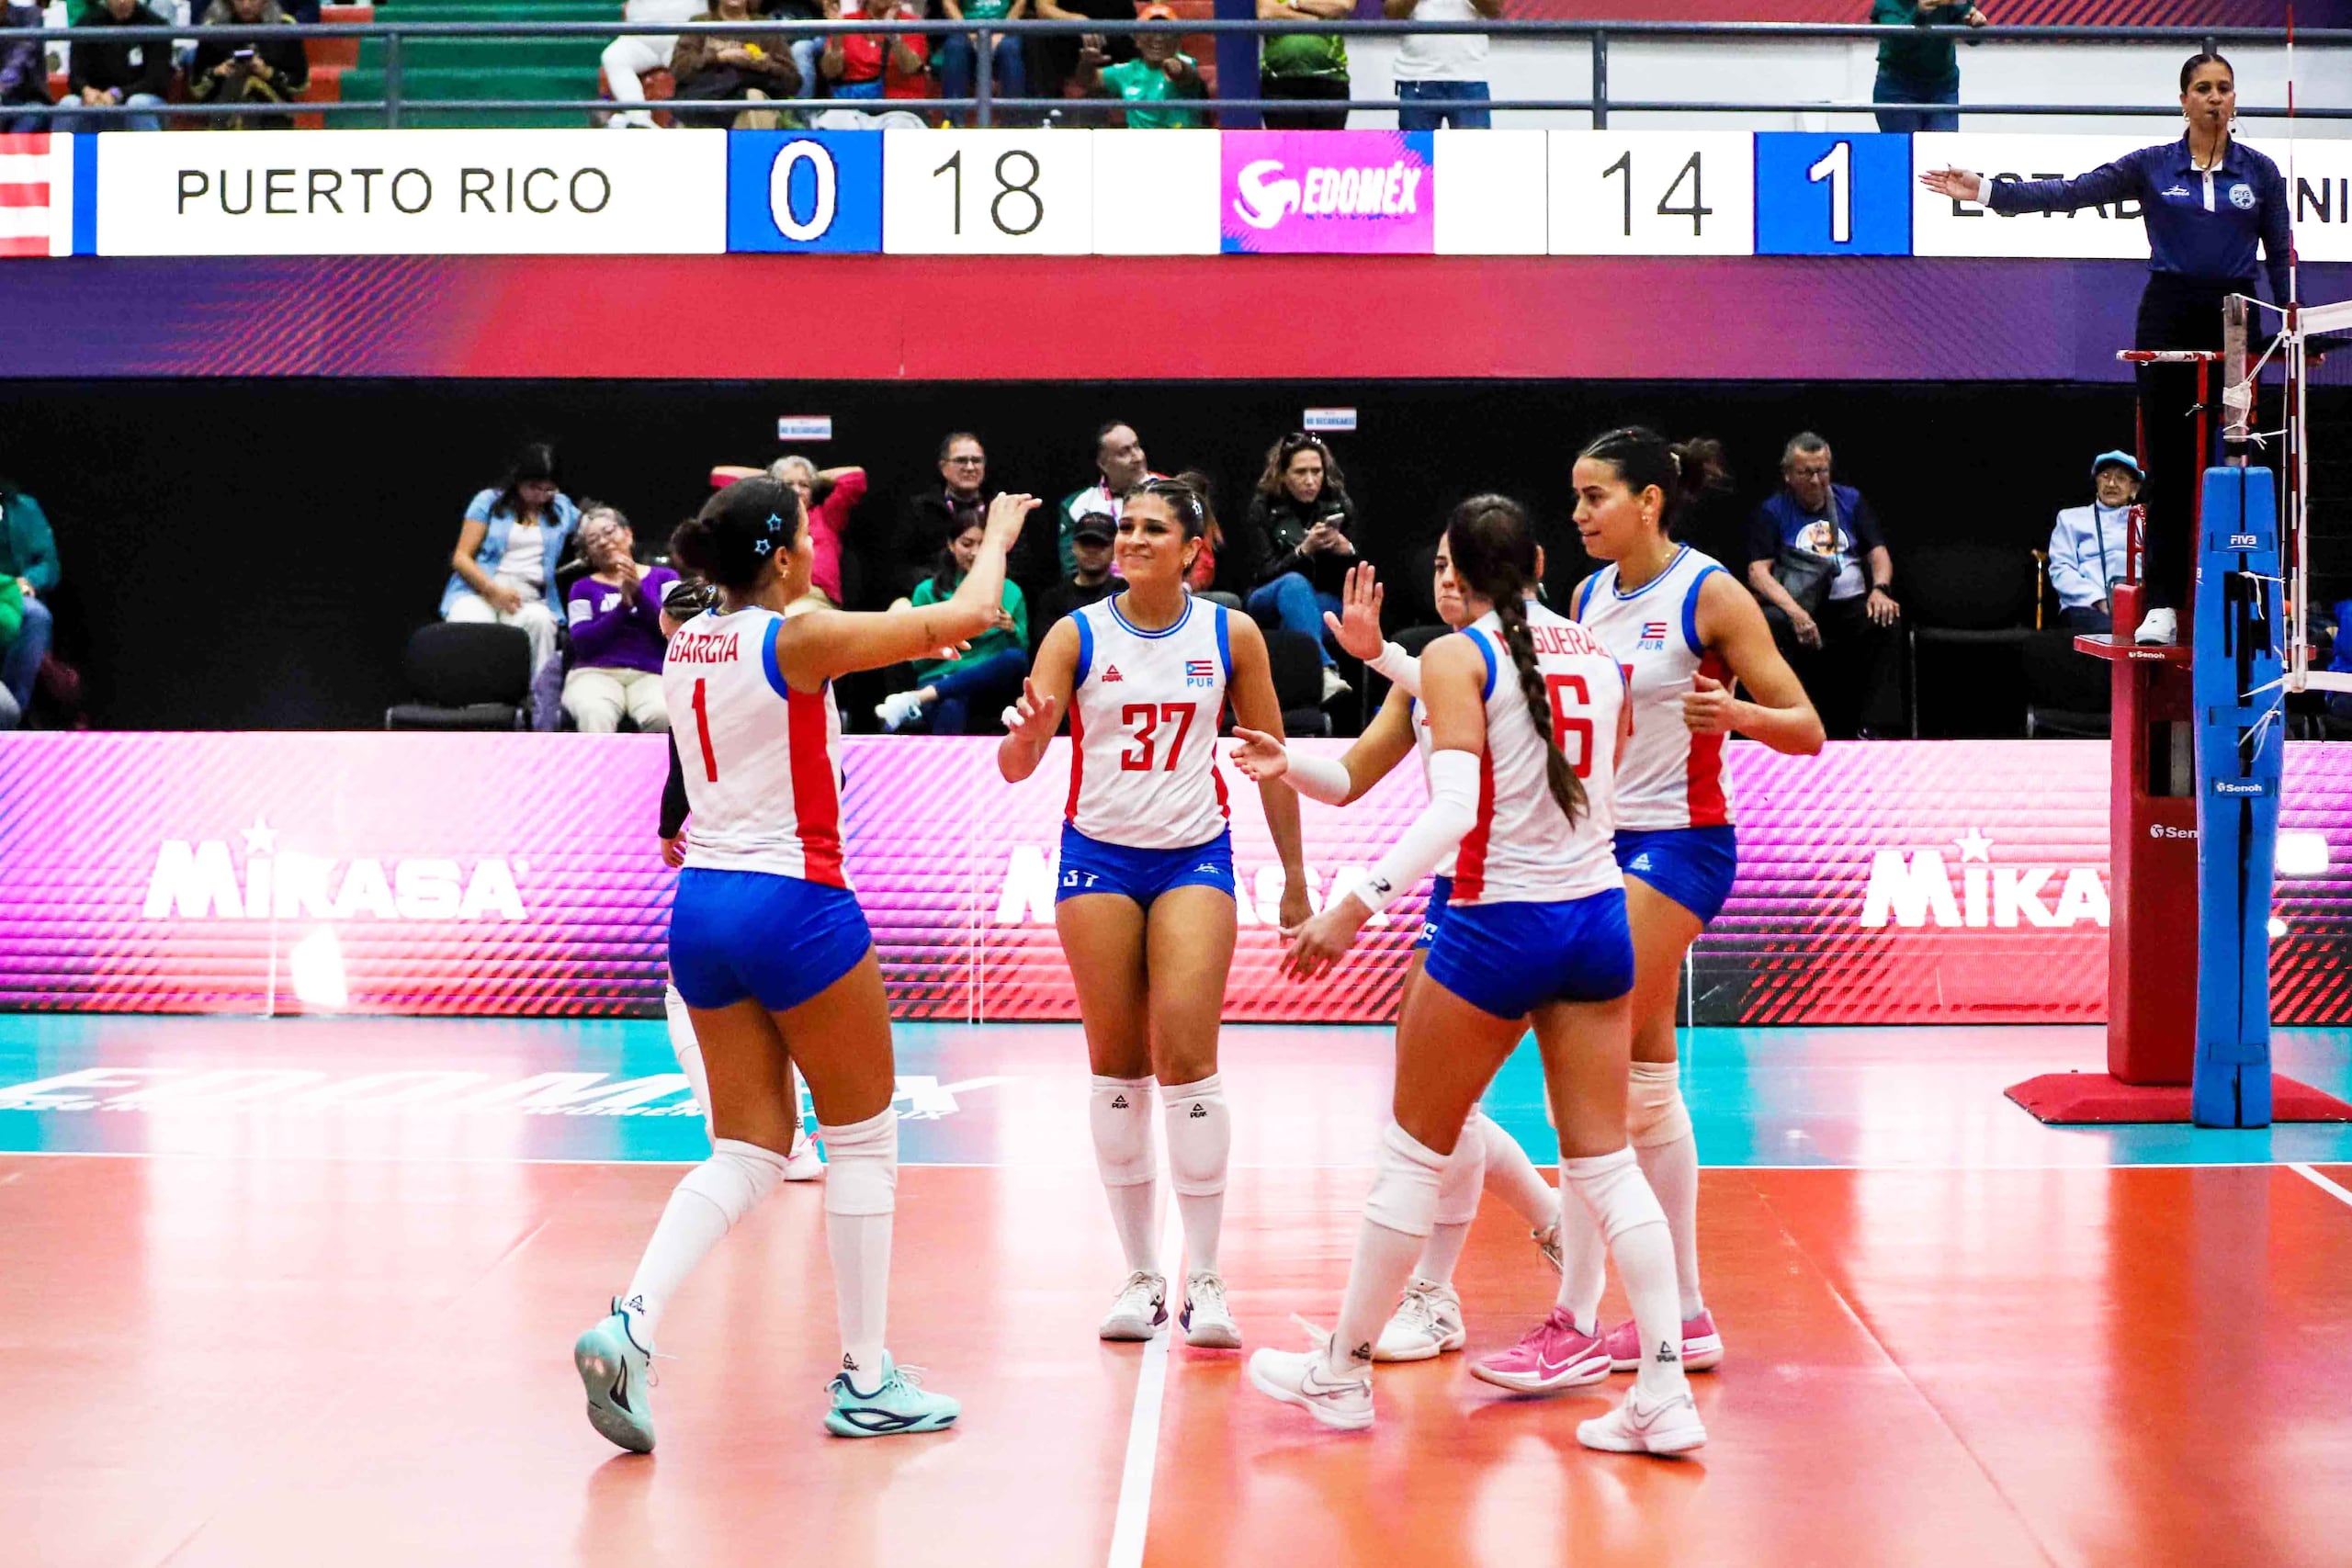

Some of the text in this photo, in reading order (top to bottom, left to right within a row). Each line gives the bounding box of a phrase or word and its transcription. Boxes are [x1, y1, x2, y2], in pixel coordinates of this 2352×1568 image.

[176, 167, 612, 215] PUERTO RICO
[770, 140, 836, 242] 0
[933, 149, 1044, 236] 18
[1602, 151, 1713, 236] 14
[1807, 140, 1850, 243] 1
[2230, 535, 2257, 546] FIVB
[668, 631, 739, 663] GARCIA
[2136, 650, 2165, 660] Senoh
[1186, 677, 1214, 688] PUR
[692, 678, 718, 783] 1
[1121, 702, 1196, 772] 37
[2225, 783, 2262, 794] Senoh
